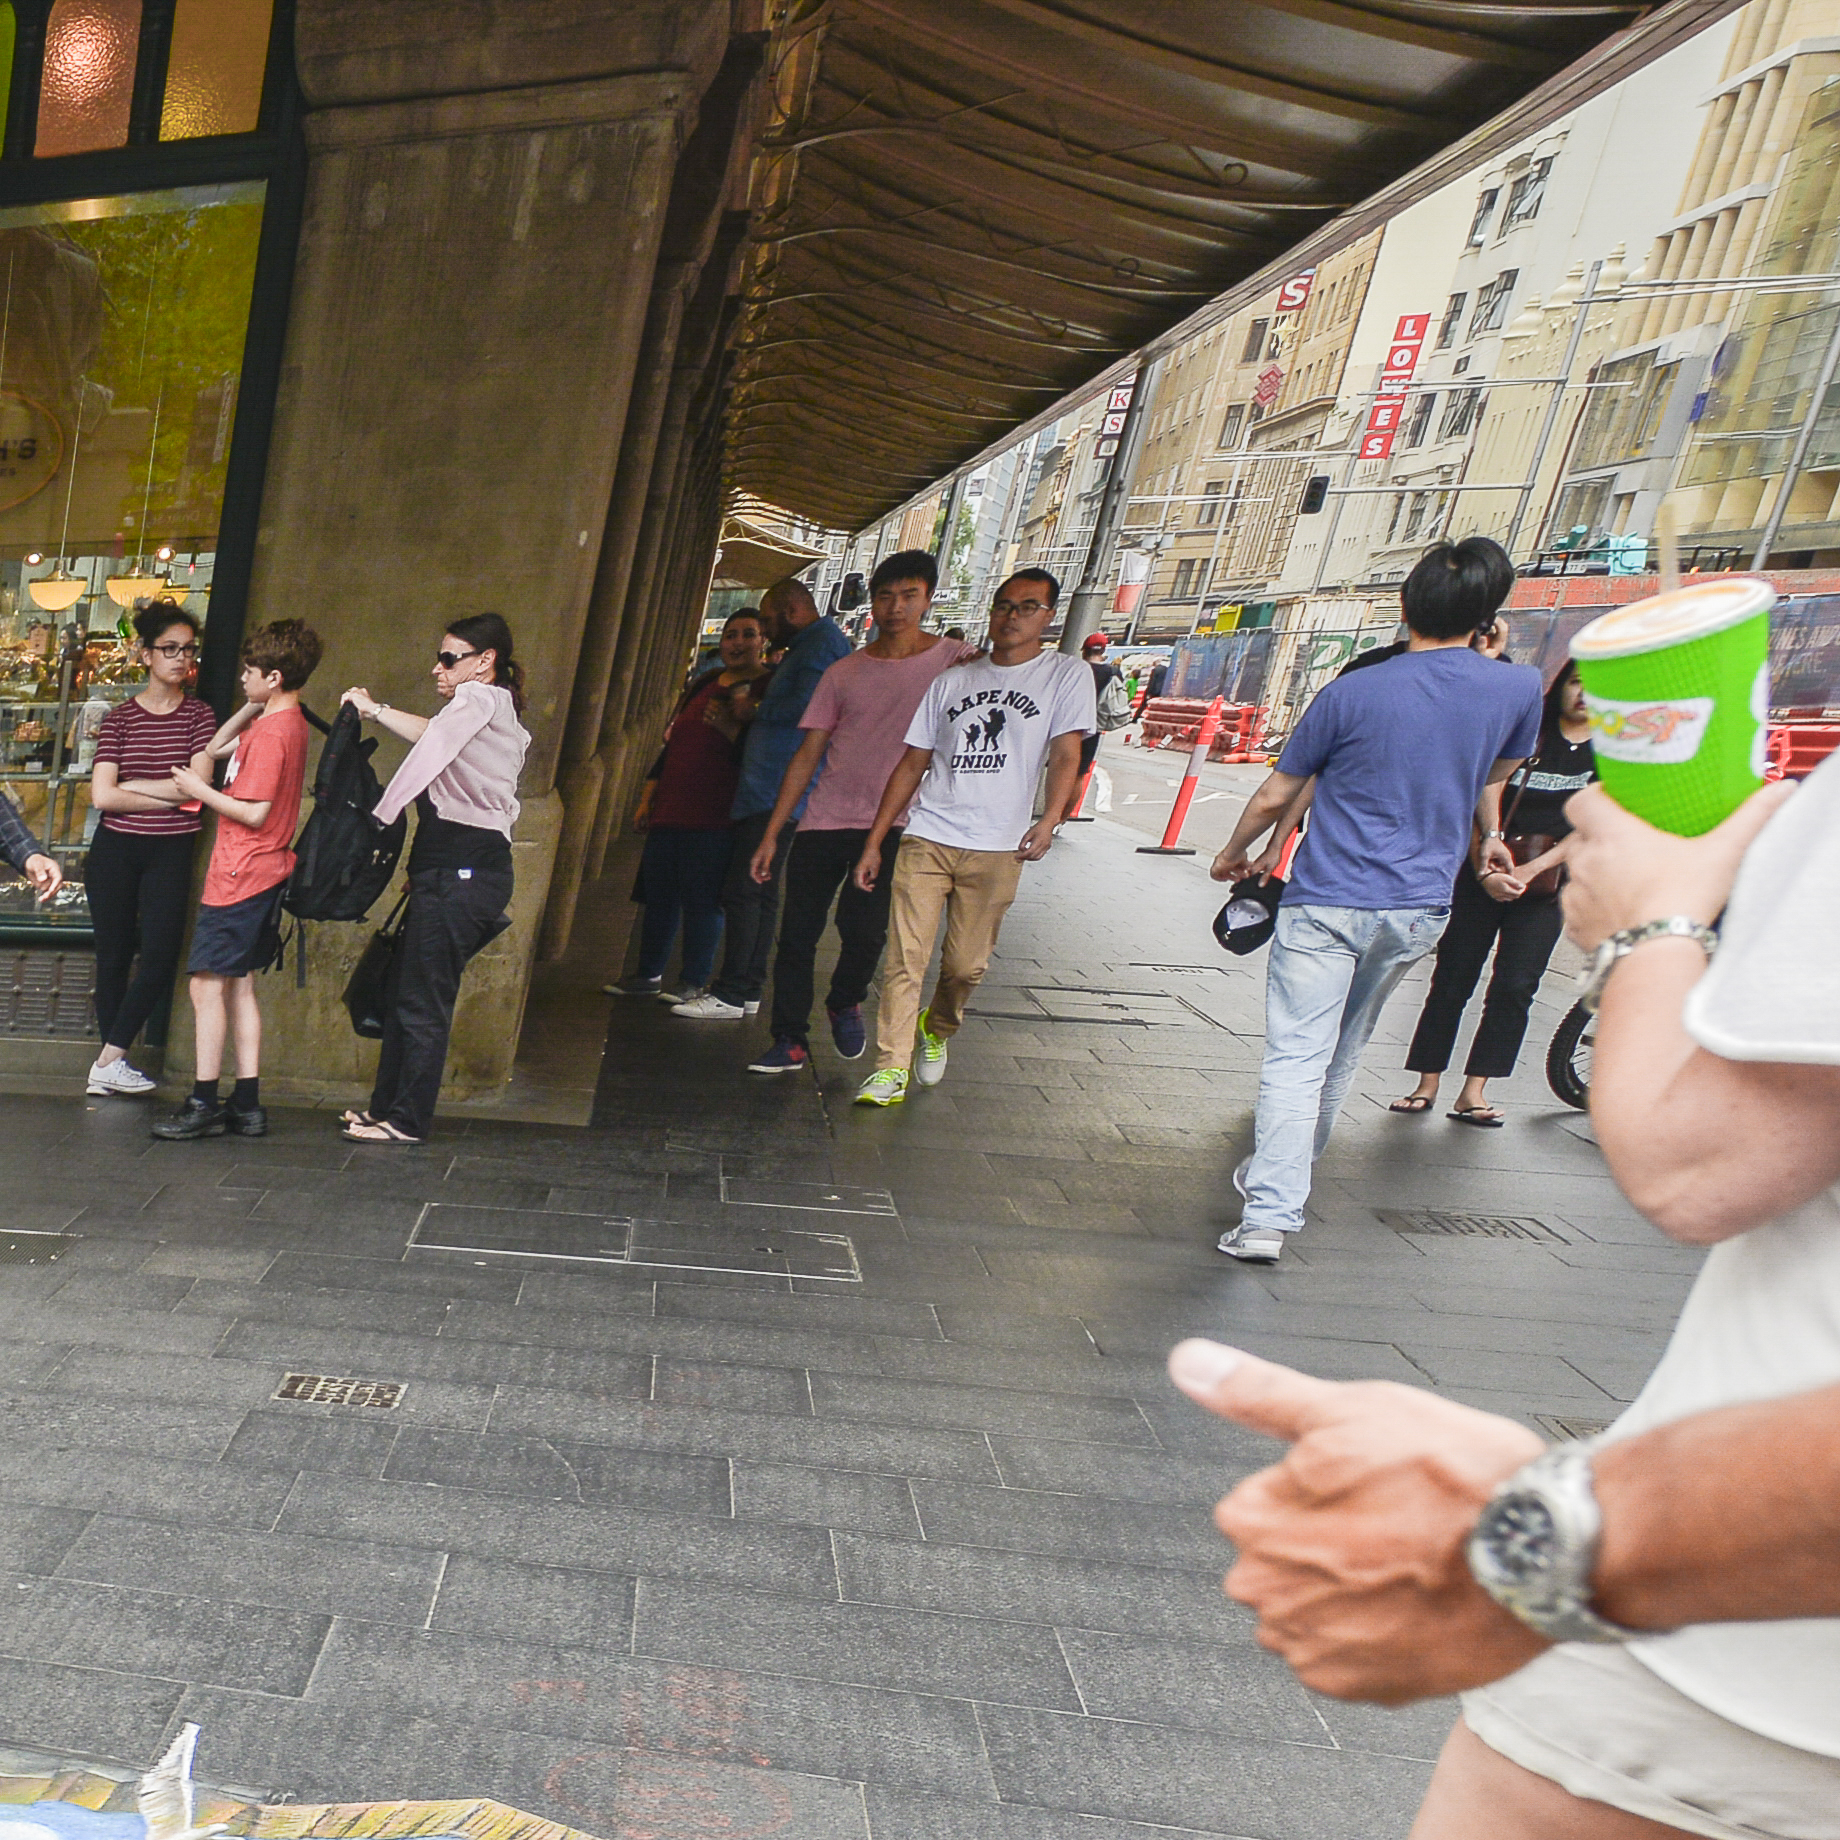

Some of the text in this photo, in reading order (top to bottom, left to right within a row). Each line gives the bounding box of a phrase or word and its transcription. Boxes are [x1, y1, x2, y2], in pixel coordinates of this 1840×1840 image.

[1365, 319, 1419, 457] LOWES
[947, 689, 1040, 723] AAPE NOW
[951, 754, 1007, 769] UNION
